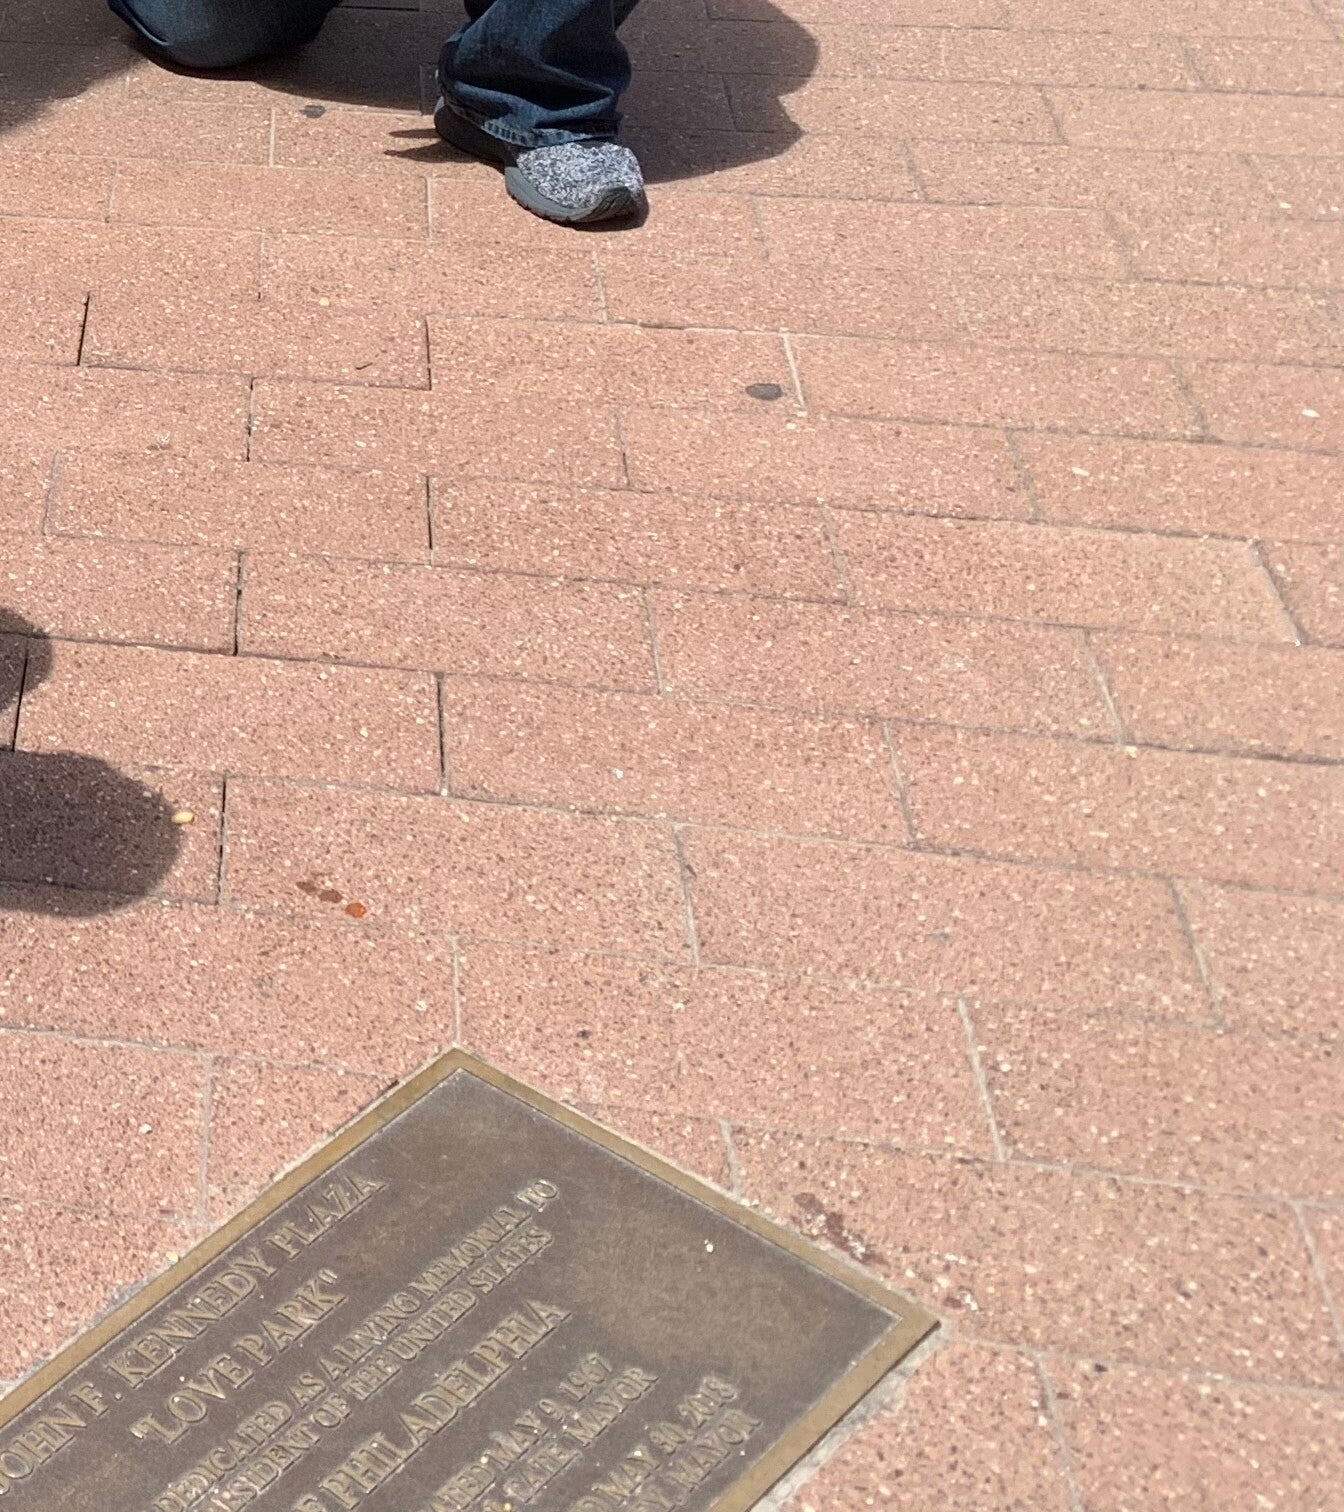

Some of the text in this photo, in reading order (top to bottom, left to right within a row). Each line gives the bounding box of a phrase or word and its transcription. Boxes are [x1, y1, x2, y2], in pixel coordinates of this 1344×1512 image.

[516, 1178, 560, 1211] TO
[107, 1246, 278, 1388] KENNEDY
[265, 1170, 387, 1260] PLAZA
[409, 1206, 533, 1300] MEMORIAL
[312, 1395, 352, 1429] OF
[342, 1357, 401, 1401] THE
[387, 1286, 479, 1363] UNITED
[465, 1226, 554, 1295] STATES
[318, 1344, 351, 1382] A
[334, 1291, 421, 1366] LIVING
[291, 1370, 328, 1410] AS
[320, 1296, 573, 1511] PHILADELPHIA
[564, 1364, 660, 1448] MAYOR
[485, 1408, 543, 1471] MAY
[666, 1407, 763, 1492] MAYOR
